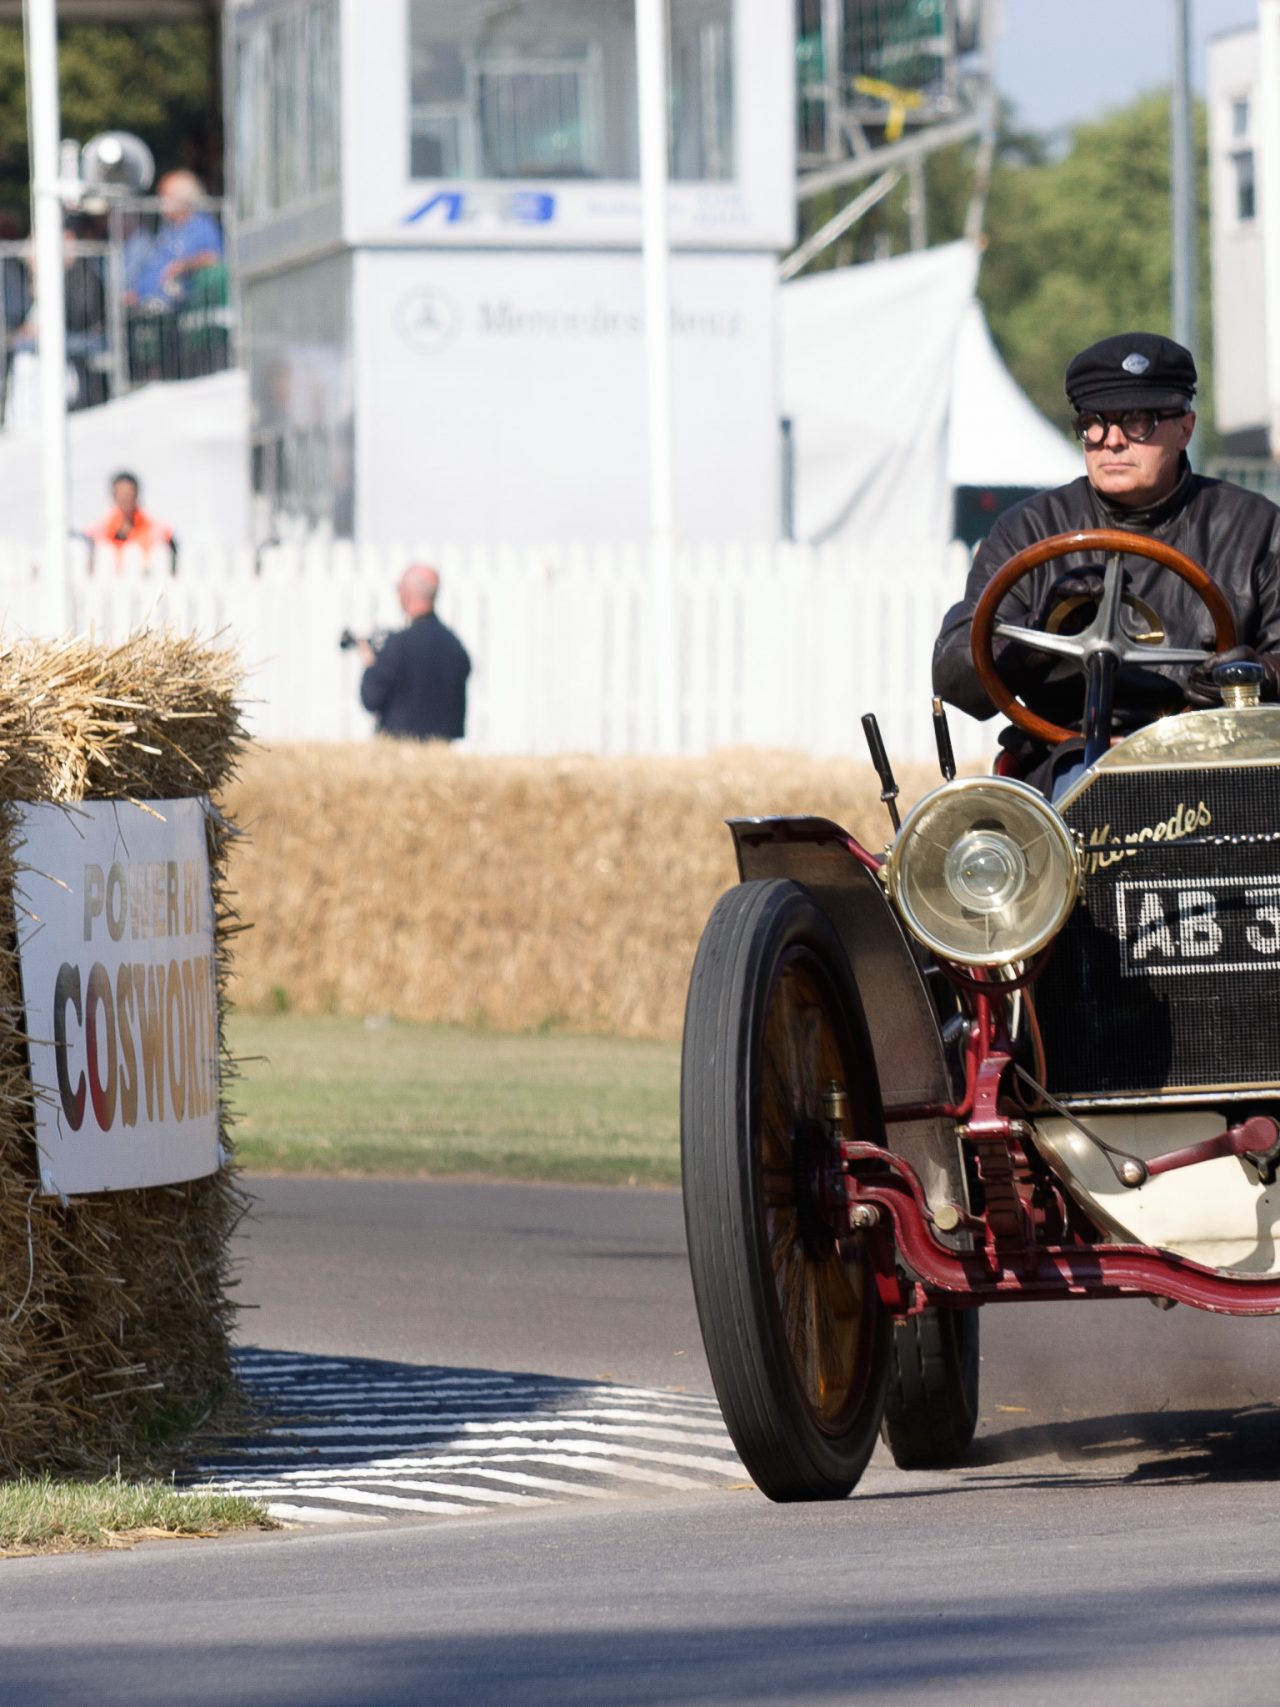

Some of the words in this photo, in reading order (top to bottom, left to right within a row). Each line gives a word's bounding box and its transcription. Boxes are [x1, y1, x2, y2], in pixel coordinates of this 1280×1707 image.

[1085, 800, 1213, 874] Mercedes
[83, 860, 180, 942] POWER
[1132, 890, 1224, 960] AB
